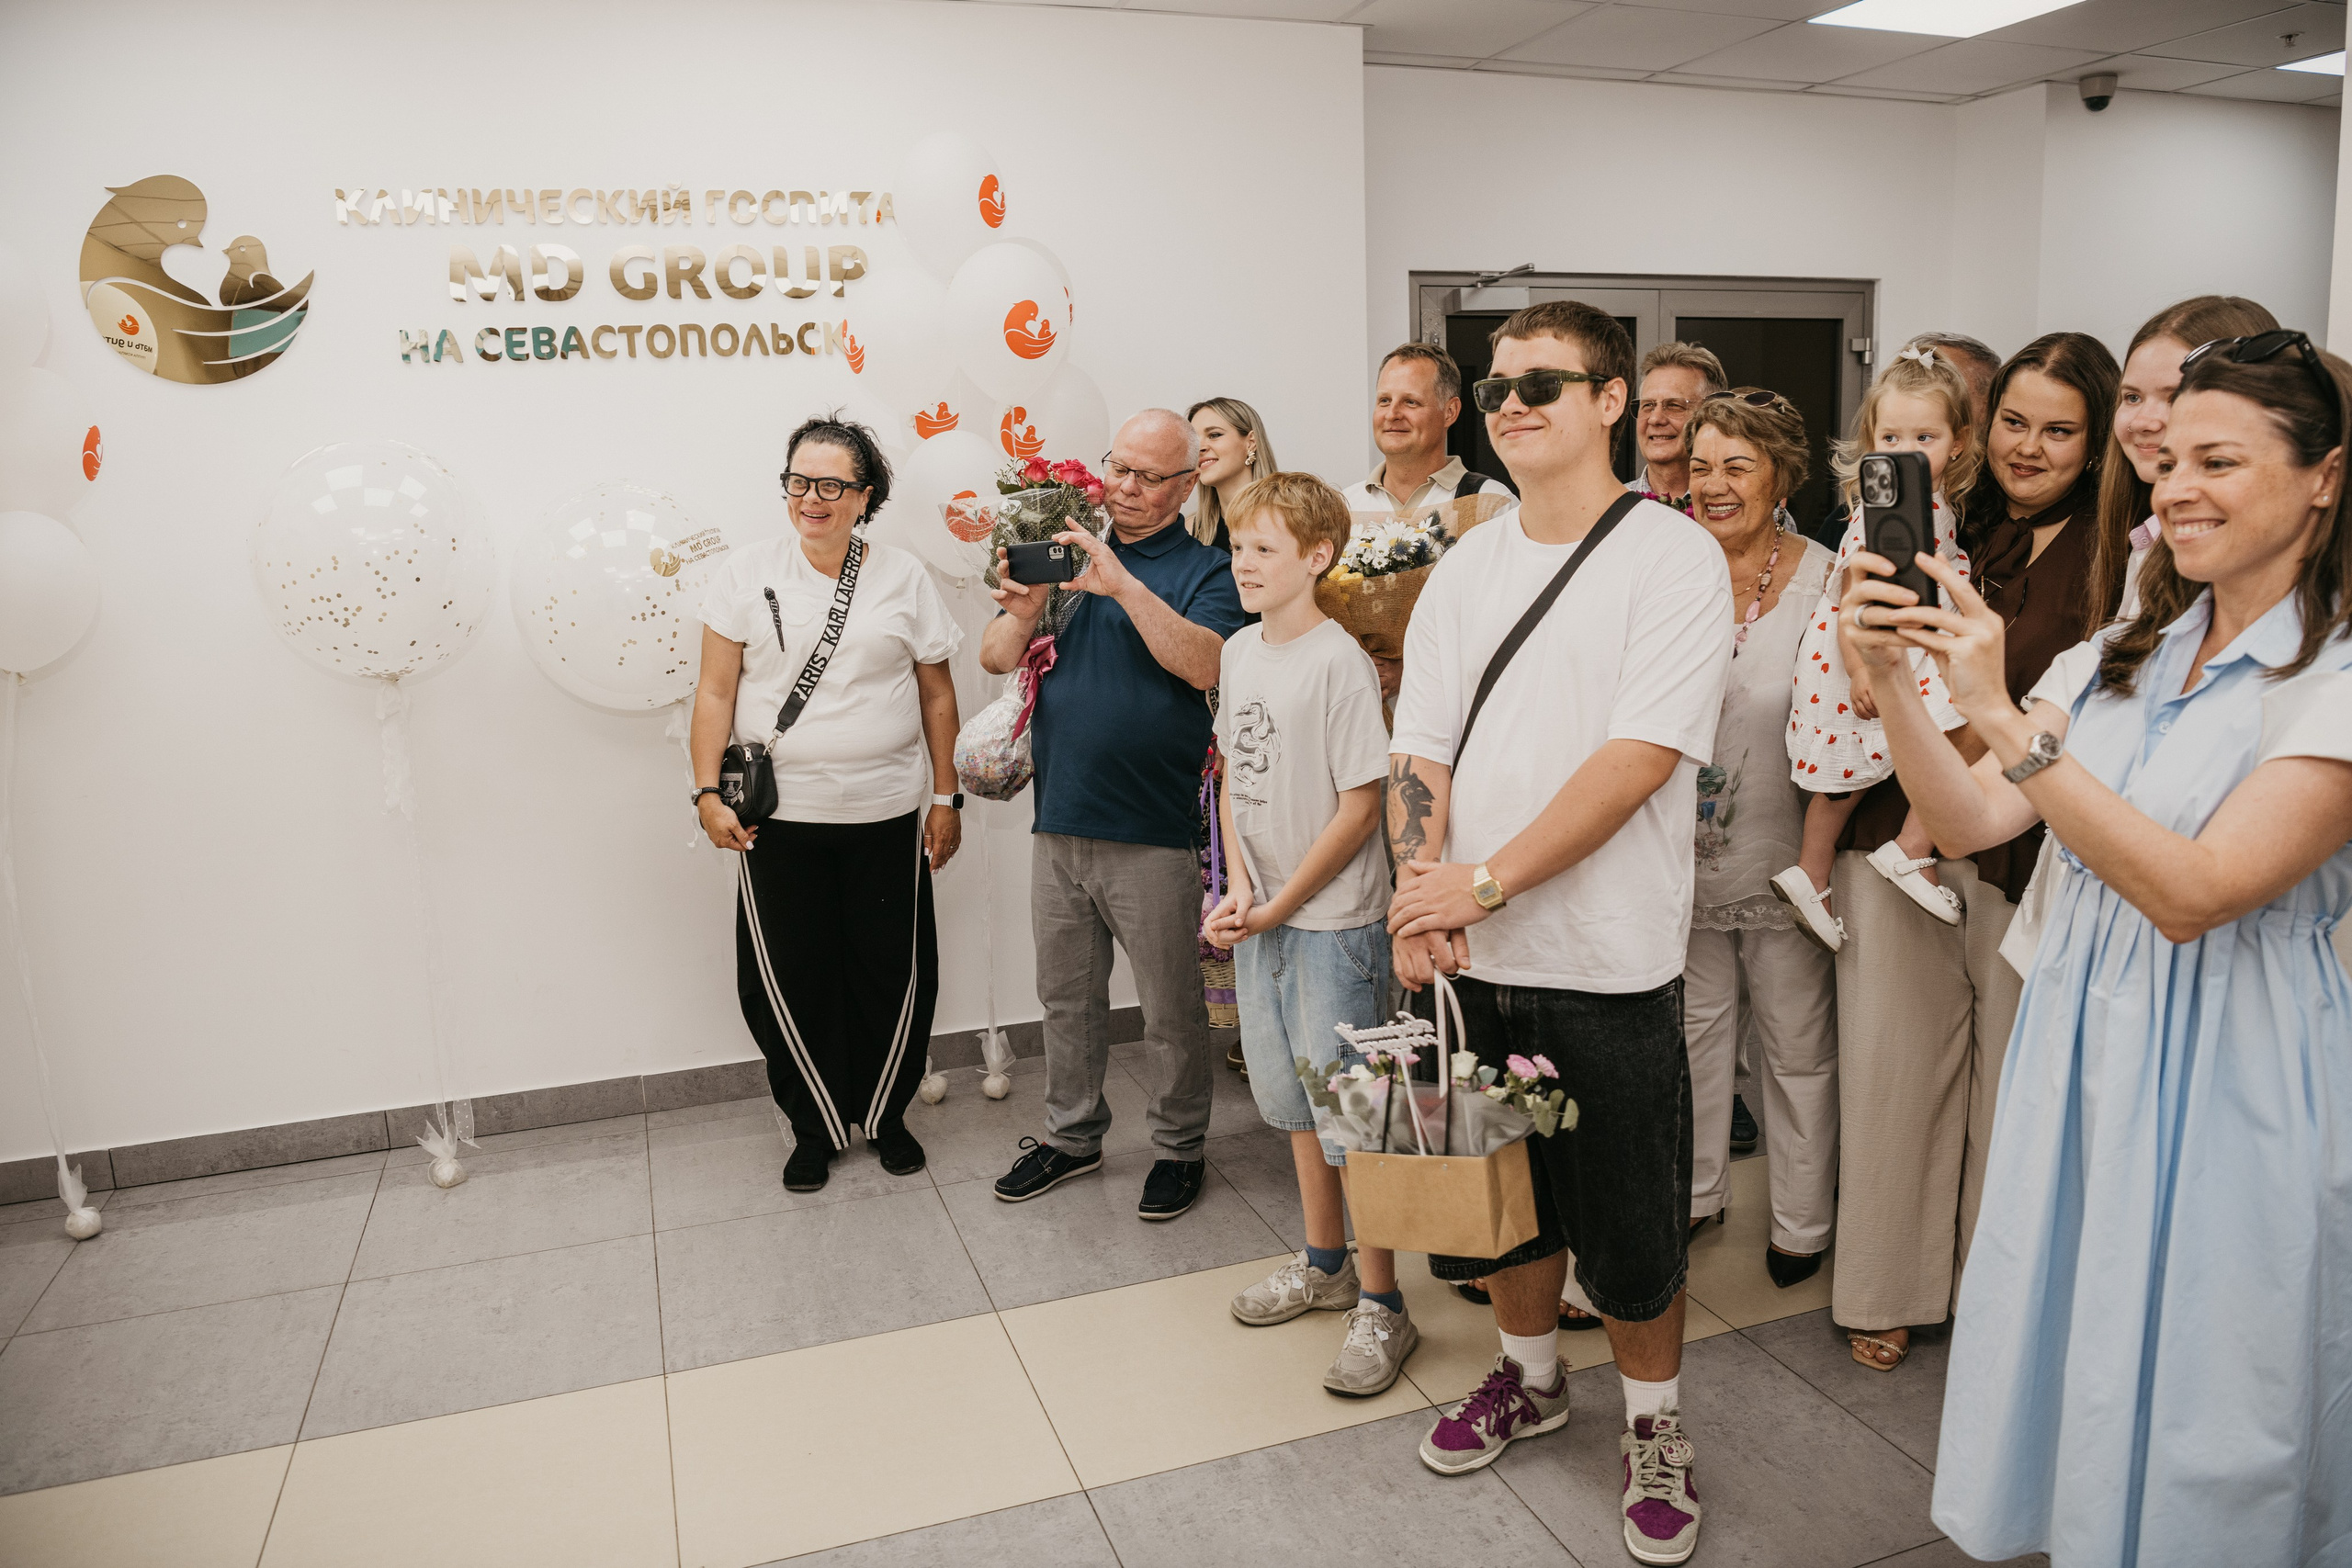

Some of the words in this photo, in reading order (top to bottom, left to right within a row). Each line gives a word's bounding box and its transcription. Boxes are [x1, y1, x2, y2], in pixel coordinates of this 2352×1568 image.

[335, 183, 692, 225] КЛИНИЧЕСКИЙ
[705, 189, 898, 225] ГОСПИТА
[449, 243, 584, 302] MD
[609, 243, 868, 301] GROUP
[400, 329, 463, 363] НА
[474, 321, 845, 362] СЕВАСТОПОЛЬСК
[689, 542, 703, 553] MD
[821, 606, 848, 647] KARL
